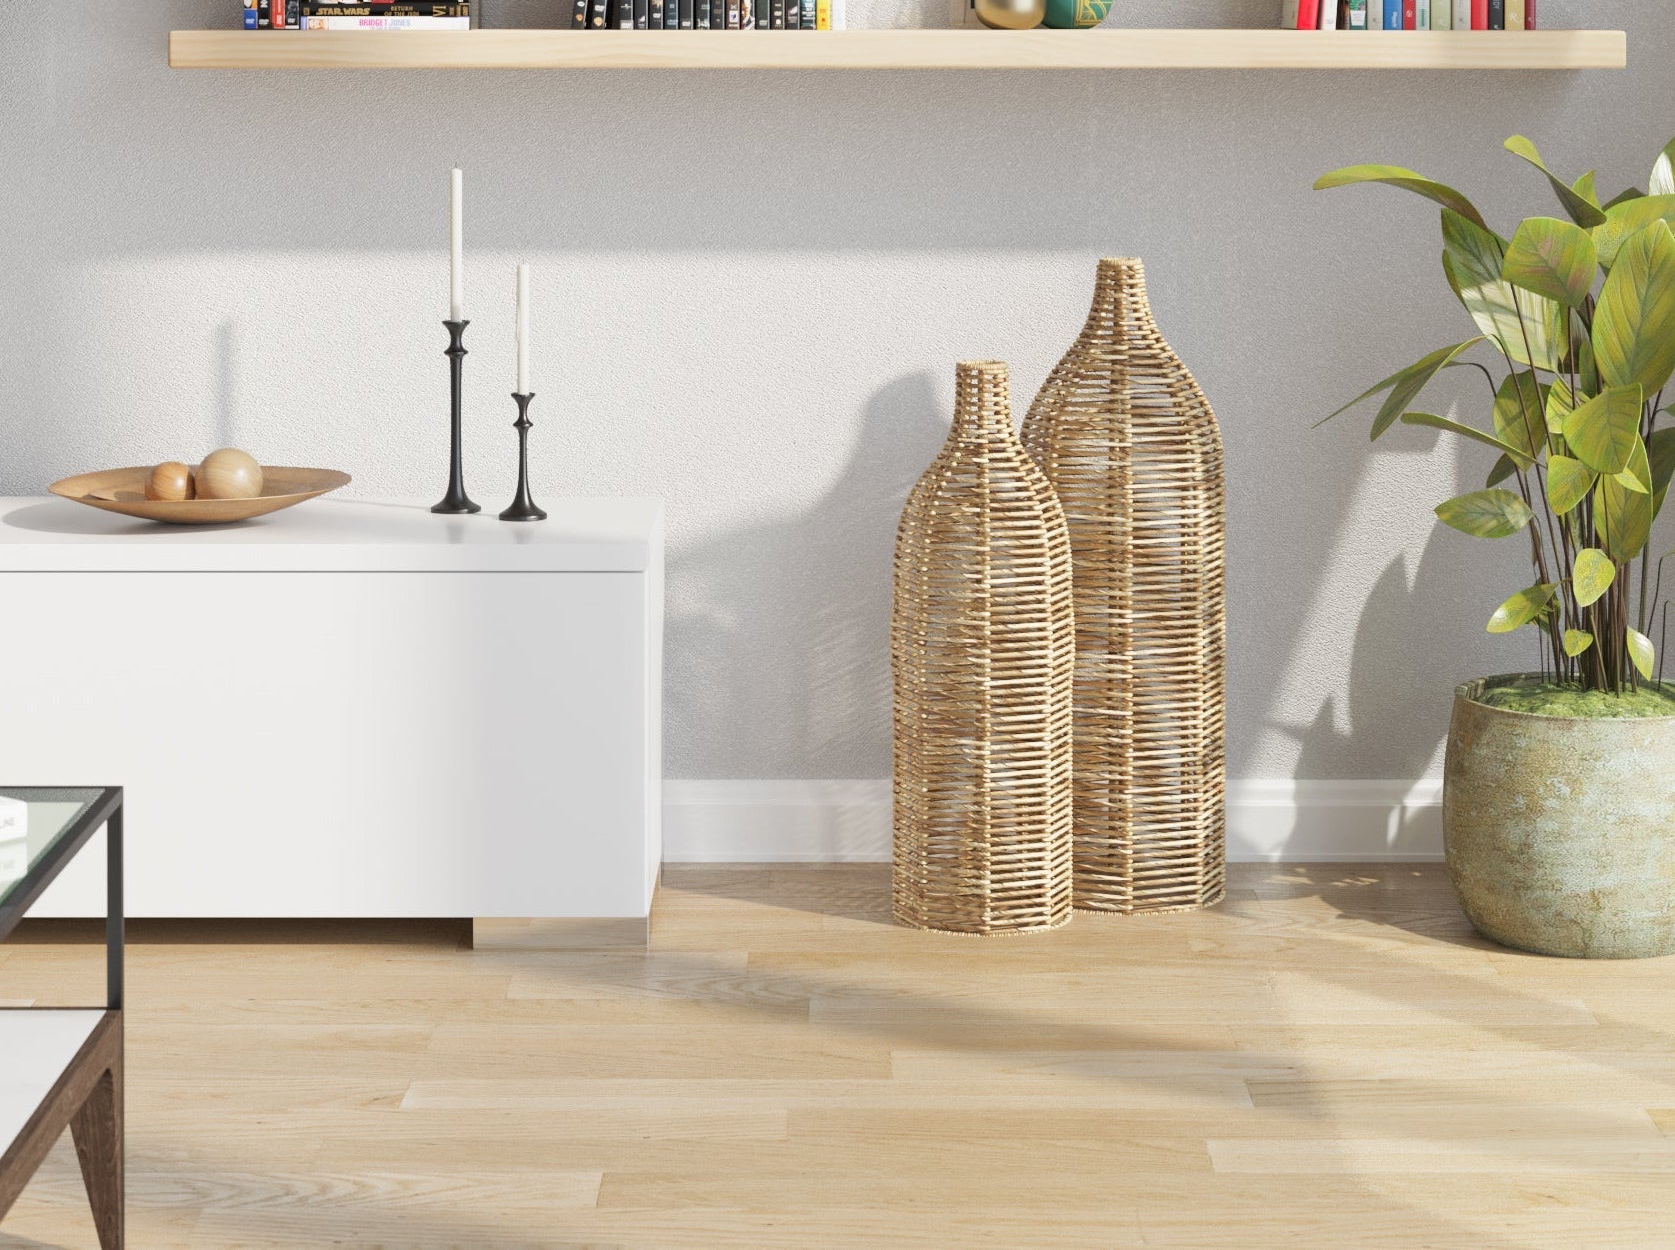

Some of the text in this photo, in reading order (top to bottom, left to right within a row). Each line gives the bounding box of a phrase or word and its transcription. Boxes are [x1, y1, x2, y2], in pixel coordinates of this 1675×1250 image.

[316, 7, 370, 16] STAR WARS
[359, 18, 388, 27] BRIDGET
